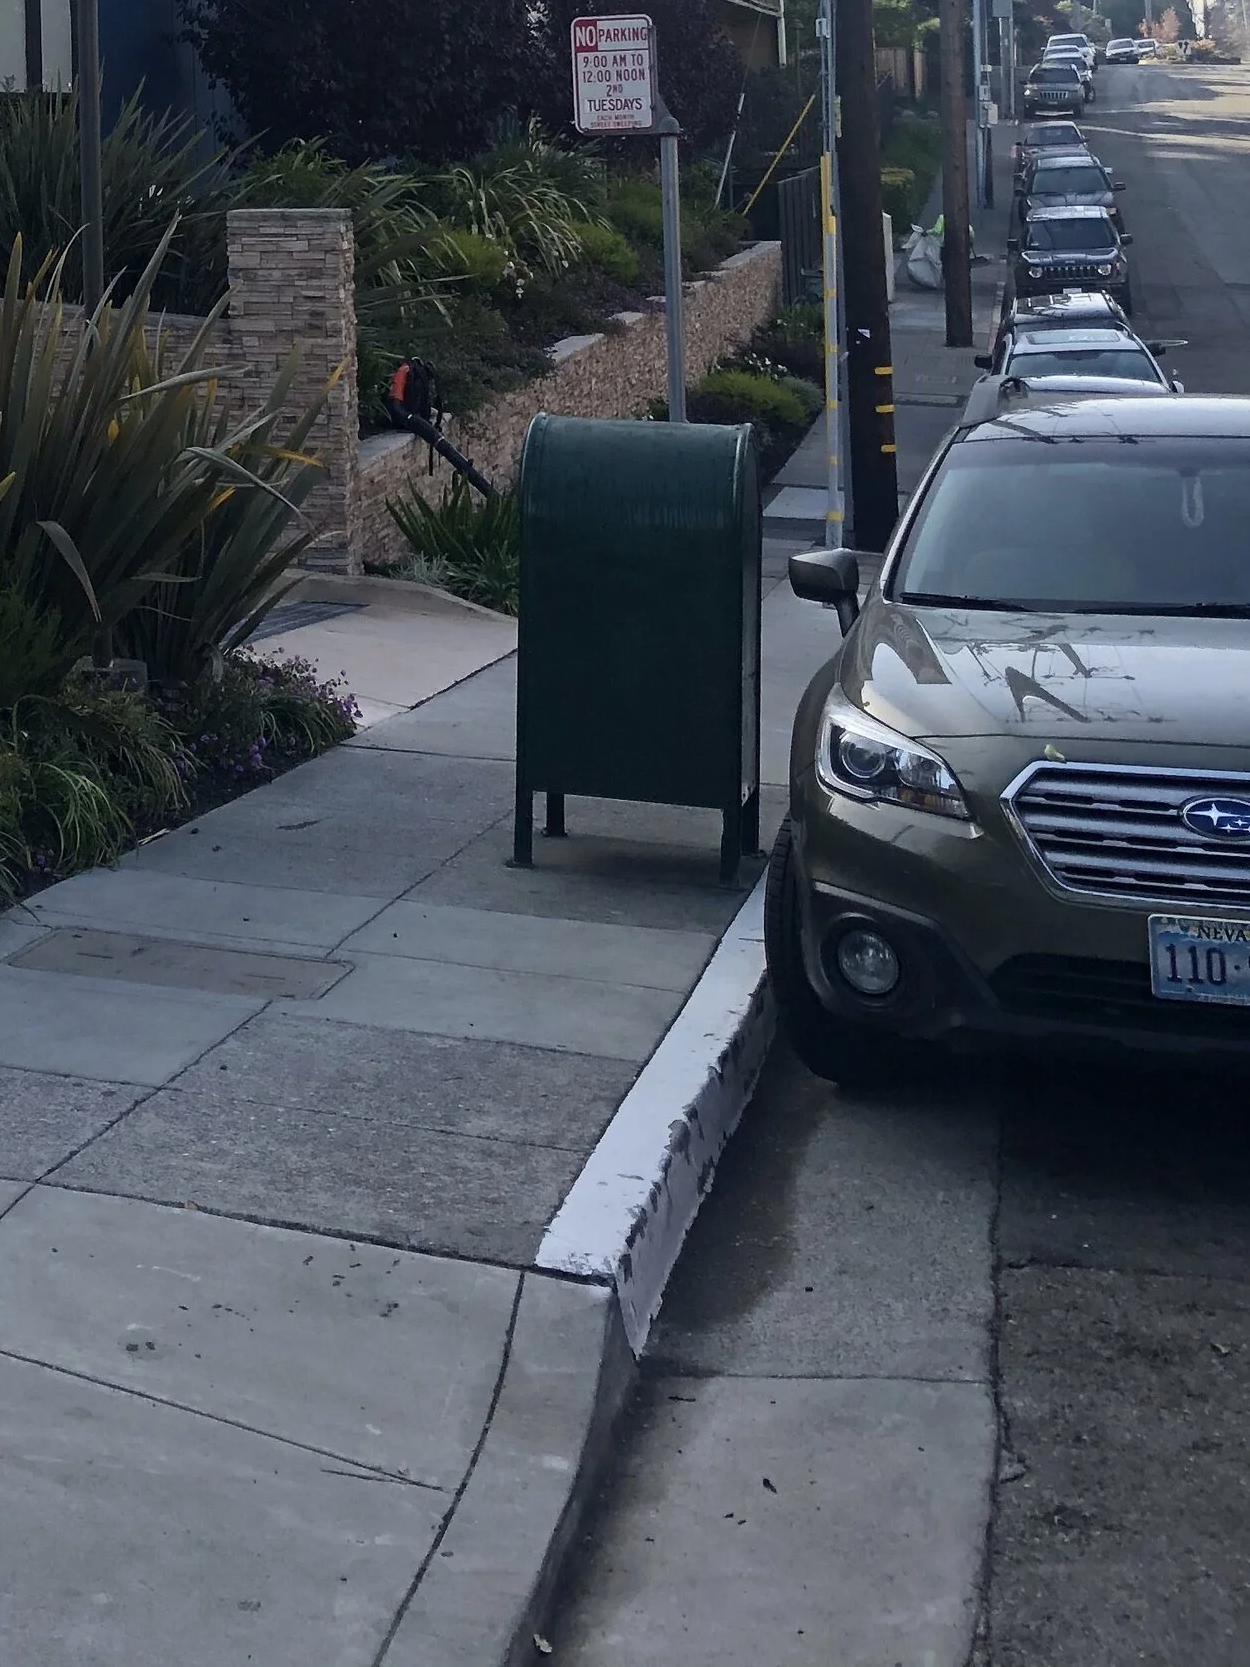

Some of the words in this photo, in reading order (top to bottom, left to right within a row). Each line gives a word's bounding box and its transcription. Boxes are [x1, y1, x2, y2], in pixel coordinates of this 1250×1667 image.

[575, 25, 597, 47] NO
[598, 26, 648, 43] PARKING
[583, 55, 607, 68] 9:00
[612, 54, 627, 68] AM
[631, 53, 643, 67] TO
[582, 70, 611, 83] 12:00
[615, 68, 645, 82] NOON
[606, 84, 623, 96] 2ND
[587, 98, 643, 112] TUESDAYS
